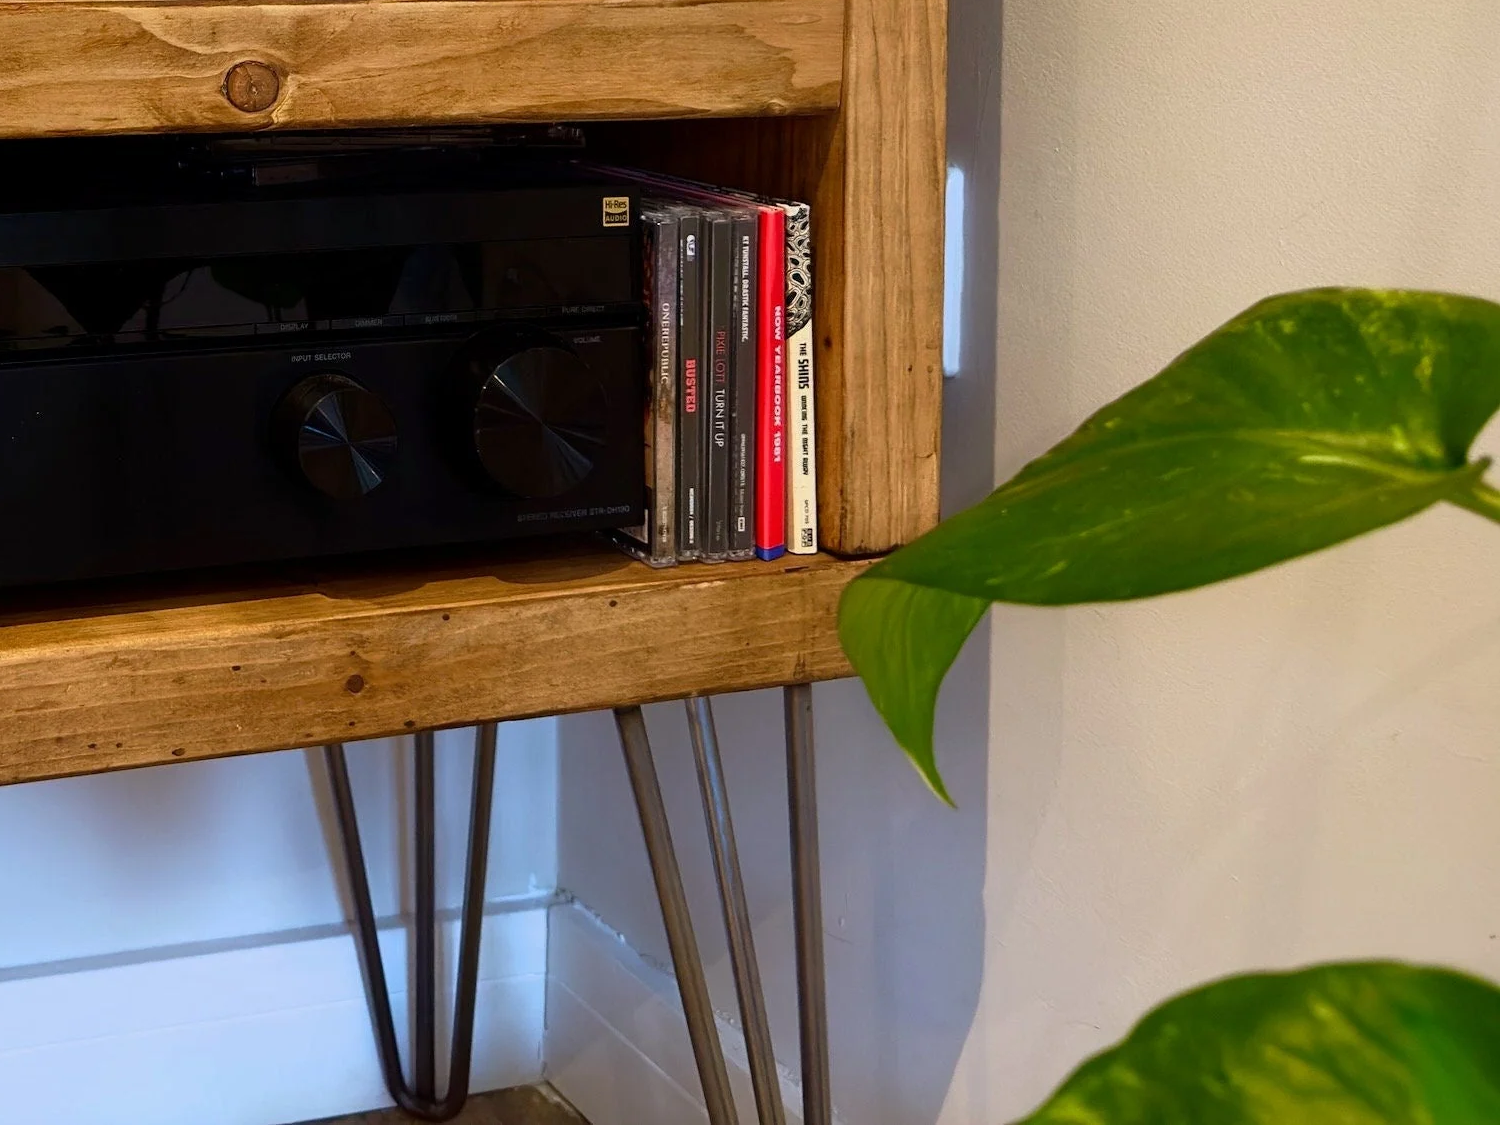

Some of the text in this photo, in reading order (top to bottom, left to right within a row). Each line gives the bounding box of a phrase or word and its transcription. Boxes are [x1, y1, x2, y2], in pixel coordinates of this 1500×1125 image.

[604, 212, 628, 225] AUDIO
[660, 302, 670, 384] ONEREPUBLIC
[797, 342, 809, 389] THE SHINS
[685, 359, 696, 412] BUSTED
[714, 388, 725, 447] TURN IT UP
